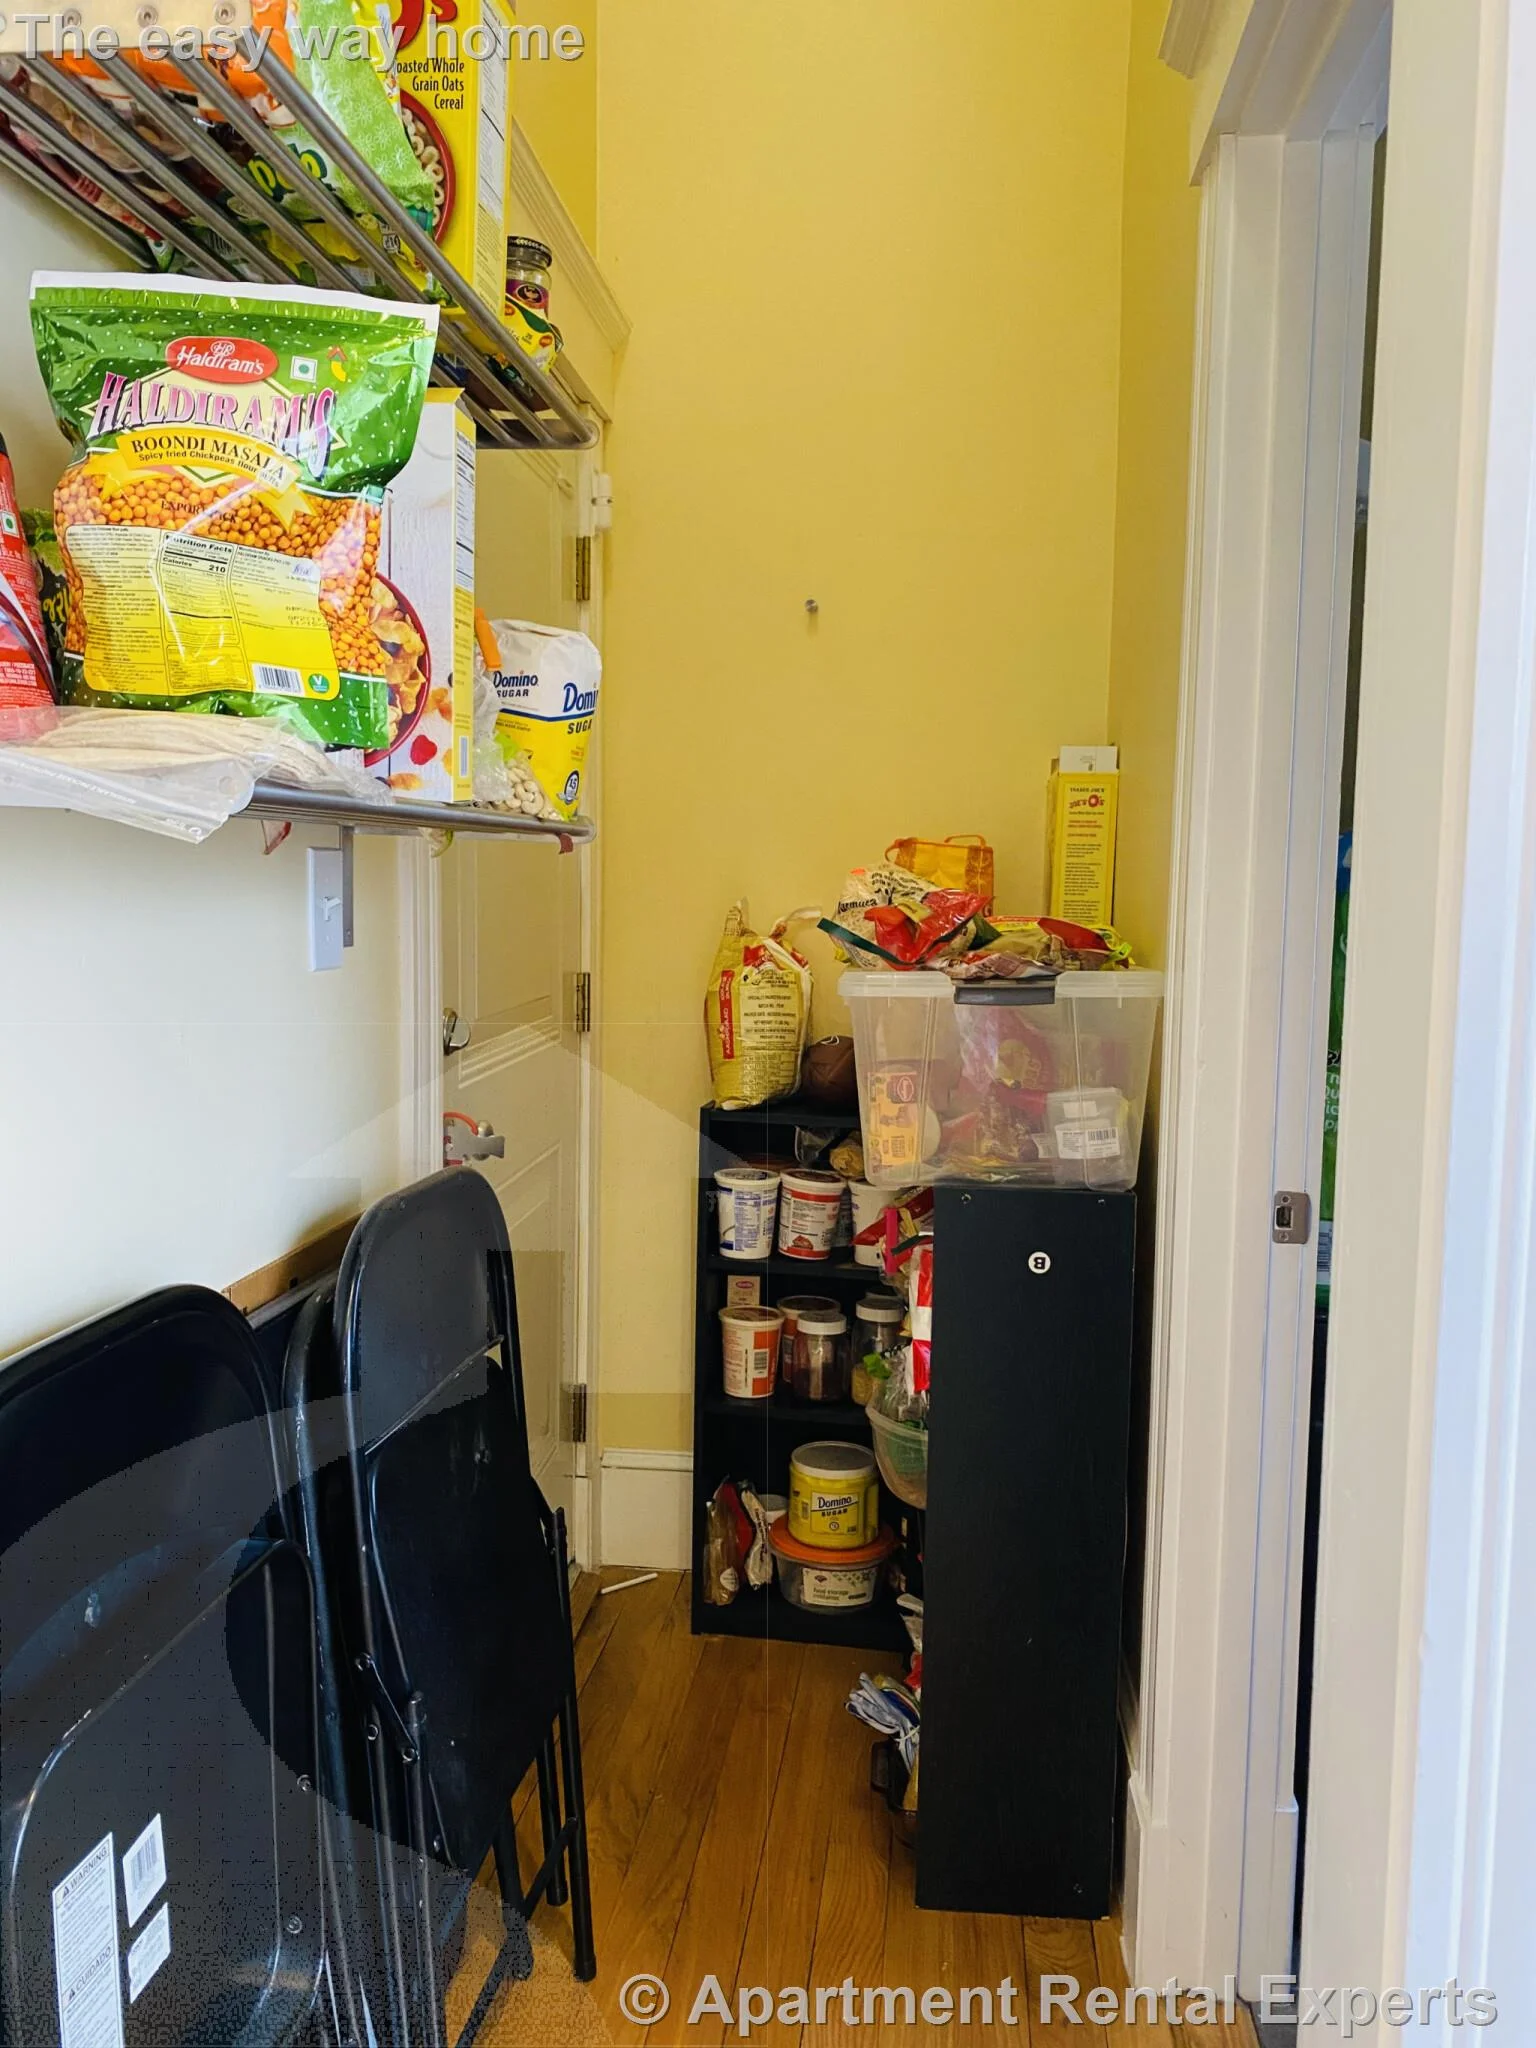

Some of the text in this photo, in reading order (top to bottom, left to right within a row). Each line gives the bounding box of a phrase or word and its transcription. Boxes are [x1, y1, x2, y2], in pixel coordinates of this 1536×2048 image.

[396, 57, 465, 73] oasted Whole
[412, 75, 464, 92] Grain Oats
[434, 93, 464, 110] Cereal
[176, 345, 265, 375] Haldiram's
[86, 371, 336, 482] HALDIRAM'S
[131, 435, 285, 481] BOONDI MASALA
[138, 452, 163, 462] Spicy
[166, 450, 187, 458] fried
[189, 450, 235, 465] Chickpeas
[237, 460, 257, 473] flour
[165, 534, 207, 549] utrition
[208, 543, 232, 553] Facts
[163, 557, 226, 573] Calories 210
[493, 670, 539, 688] Domino
[496, 688, 530, 698] SUGAR
[563, 682, 598, 713] Domi
[1033, 1256, 1047, 1270] B
[817, 1496, 852, 1509] Domino
[821, 1508, 848, 1517] SUGAR
[71, 1846, 107, 1891] WARNING
[76, 1946, 111, 1992] CUIDADO
